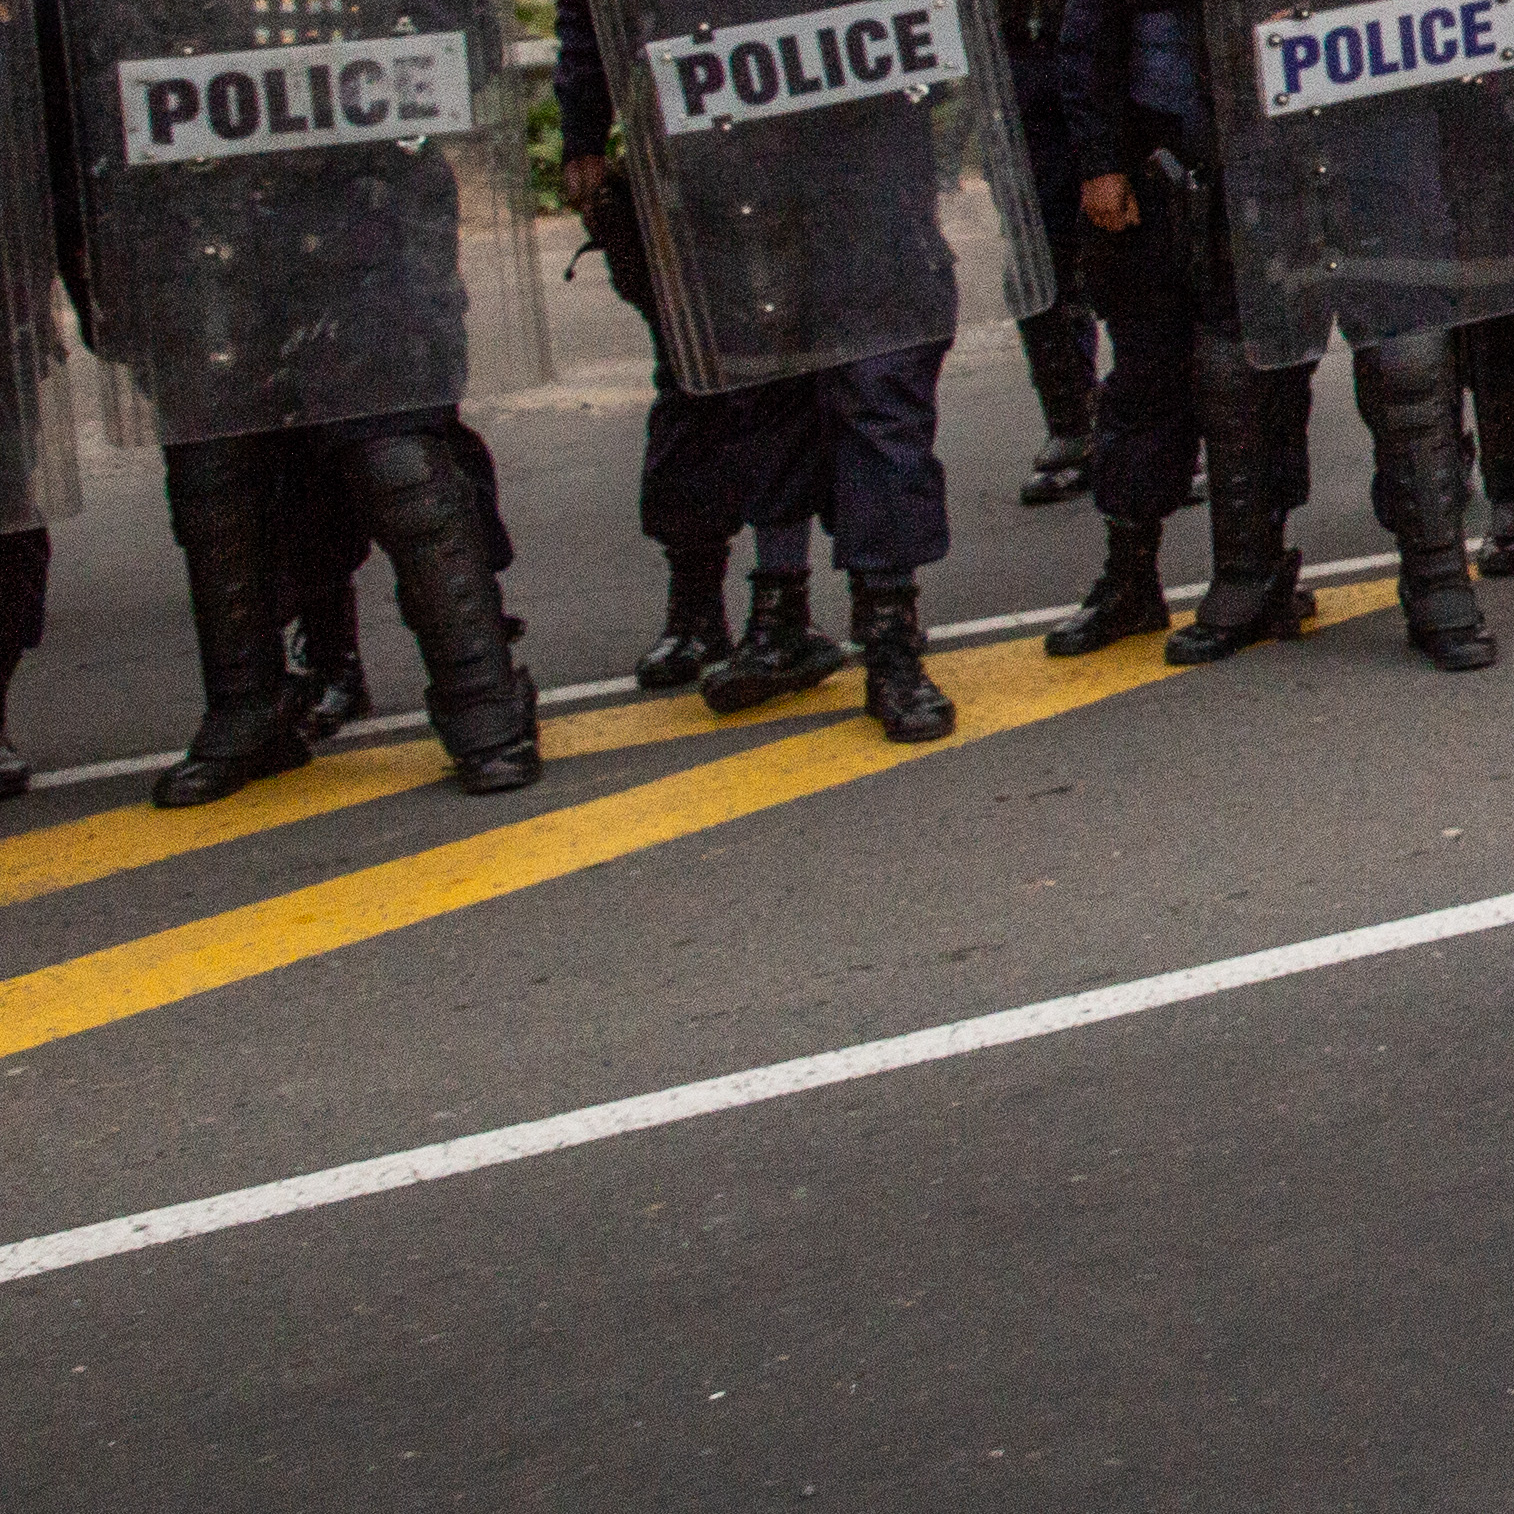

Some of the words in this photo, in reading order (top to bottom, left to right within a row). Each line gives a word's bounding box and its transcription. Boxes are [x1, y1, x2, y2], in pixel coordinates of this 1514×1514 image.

[675, 10, 938, 117] POLICE
[1280, 0, 1496, 93] POLICE
[145, 53, 440, 146] POLICE
